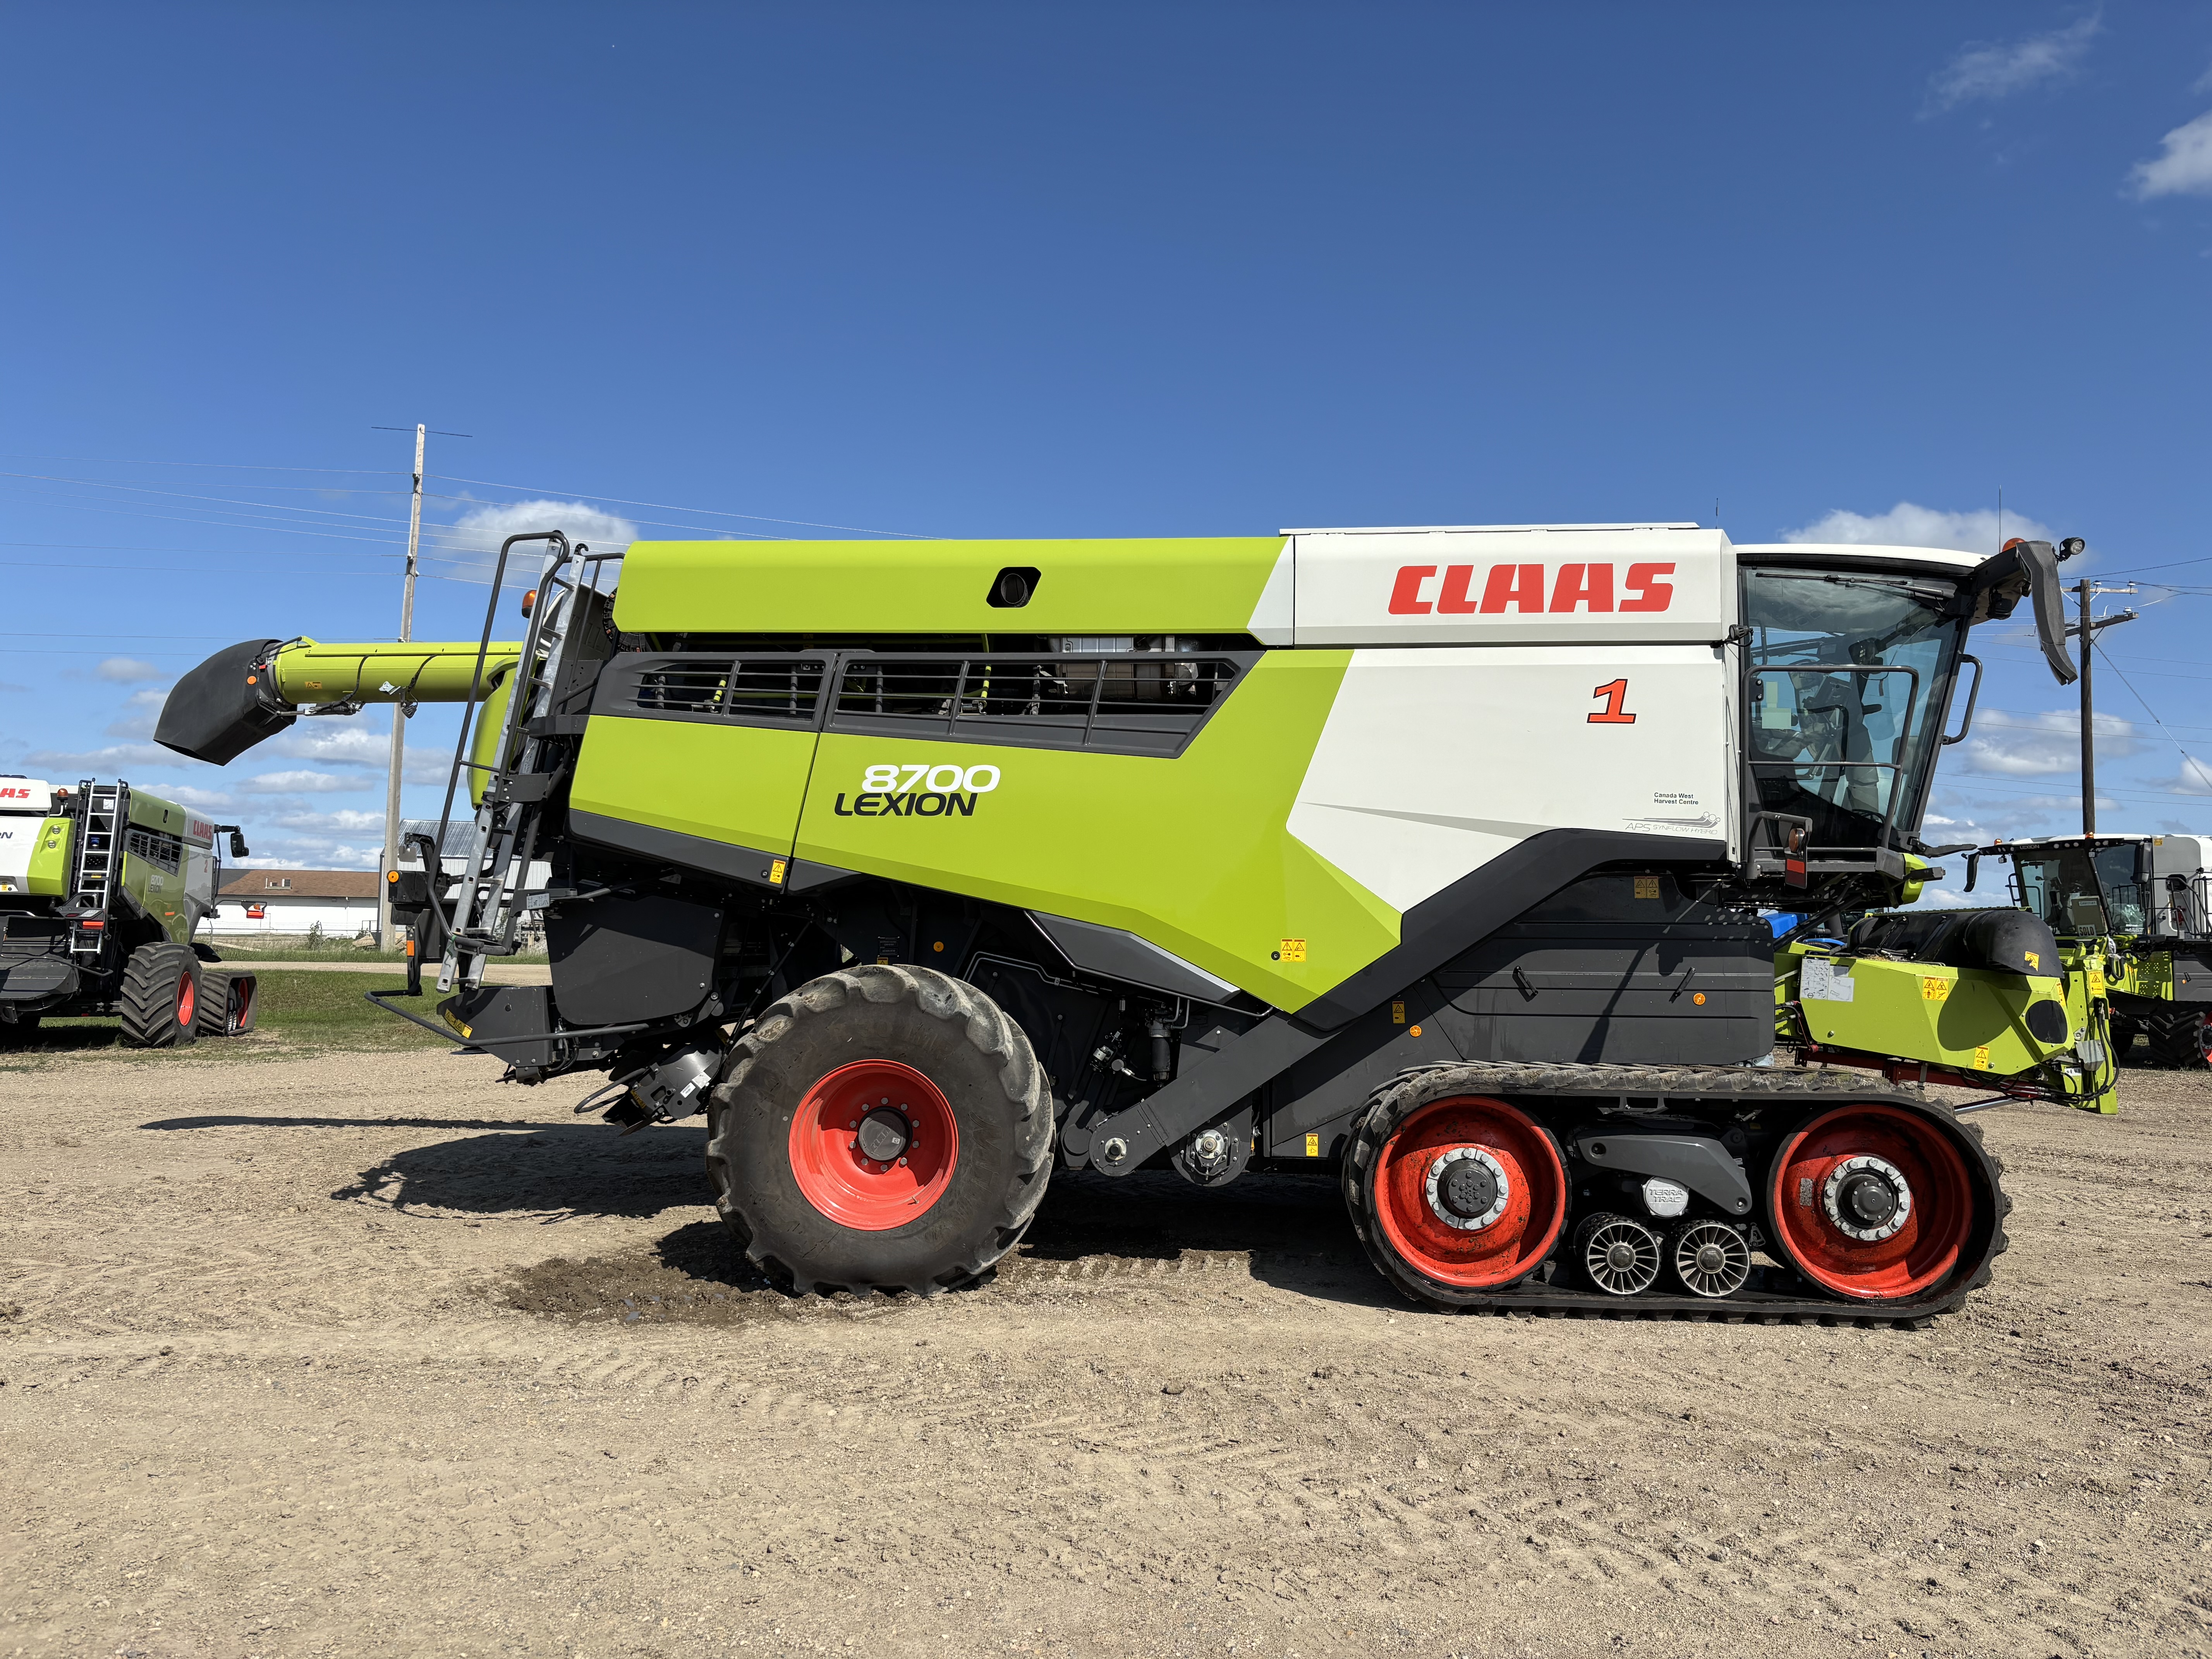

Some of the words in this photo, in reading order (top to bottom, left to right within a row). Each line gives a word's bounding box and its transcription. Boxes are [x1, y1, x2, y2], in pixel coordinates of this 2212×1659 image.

[1388, 562, 1676, 615] CLAAS
[1587, 678, 1637, 724] 1
[861, 764, 1001, 793] 8700
[834, 793, 978, 816] LEXION
[193, 820, 212, 840] CLAAS
[1625, 823, 1652, 832] APS
[204, 860, 208, 873] 2
[151, 874, 163, 886] 8700
[148, 883, 162, 894] LEXION
[2079, 927, 2094, 936] SOLD
